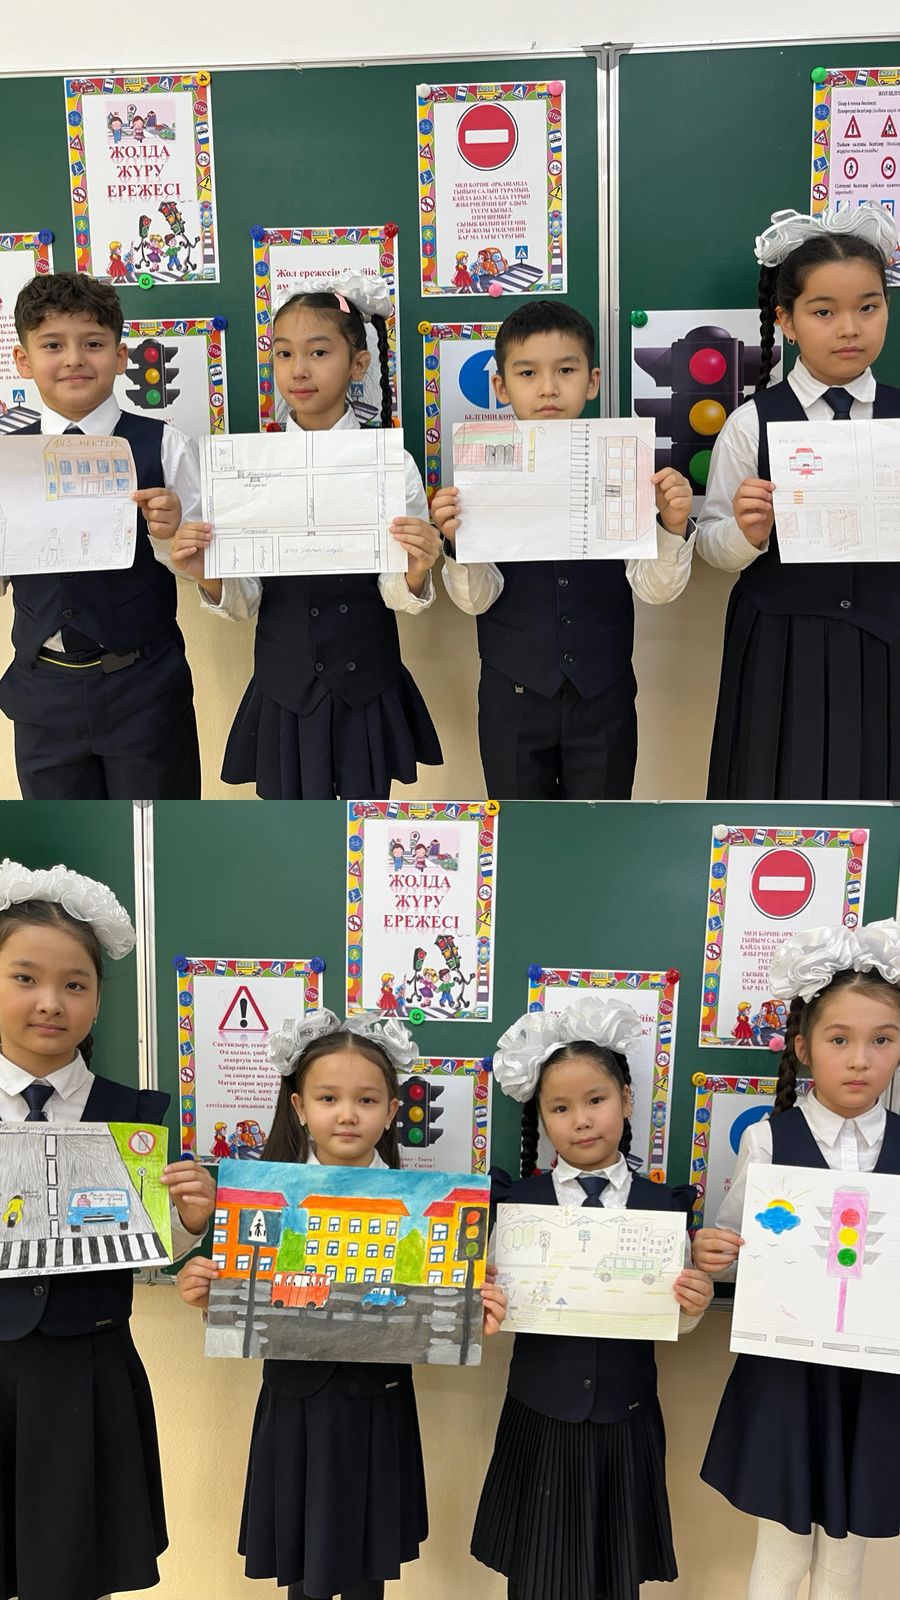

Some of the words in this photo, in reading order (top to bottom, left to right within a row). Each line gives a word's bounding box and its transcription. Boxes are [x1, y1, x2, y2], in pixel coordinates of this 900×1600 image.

[548, 112, 561, 120] STOP
[109, 145, 170, 158] ЖОЛДА
[117, 164, 164, 177] ЖҮРУ
[107, 183, 180, 197] ЕРЕЖЕСІ
[381, 256, 394, 265] STOP
[37, 262, 49, 270] STOP
[277, 269, 296, 277] Жол
[300, 268, 340, 278] ережесін
[480, 834, 493, 843] STOP
[849, 861, 862, 870] STOP
[389, 874, 451, 888] ЖОЛДА
[395, 895, 444, 908] ЖҮРУ
[384, 915, 459, 928] ЕРЕЖЕСІ
[306, 990, 318, 998] STOP
[660, 1003, 673, 1011] STOP
[475, 1088, 488, 1096] STOP
